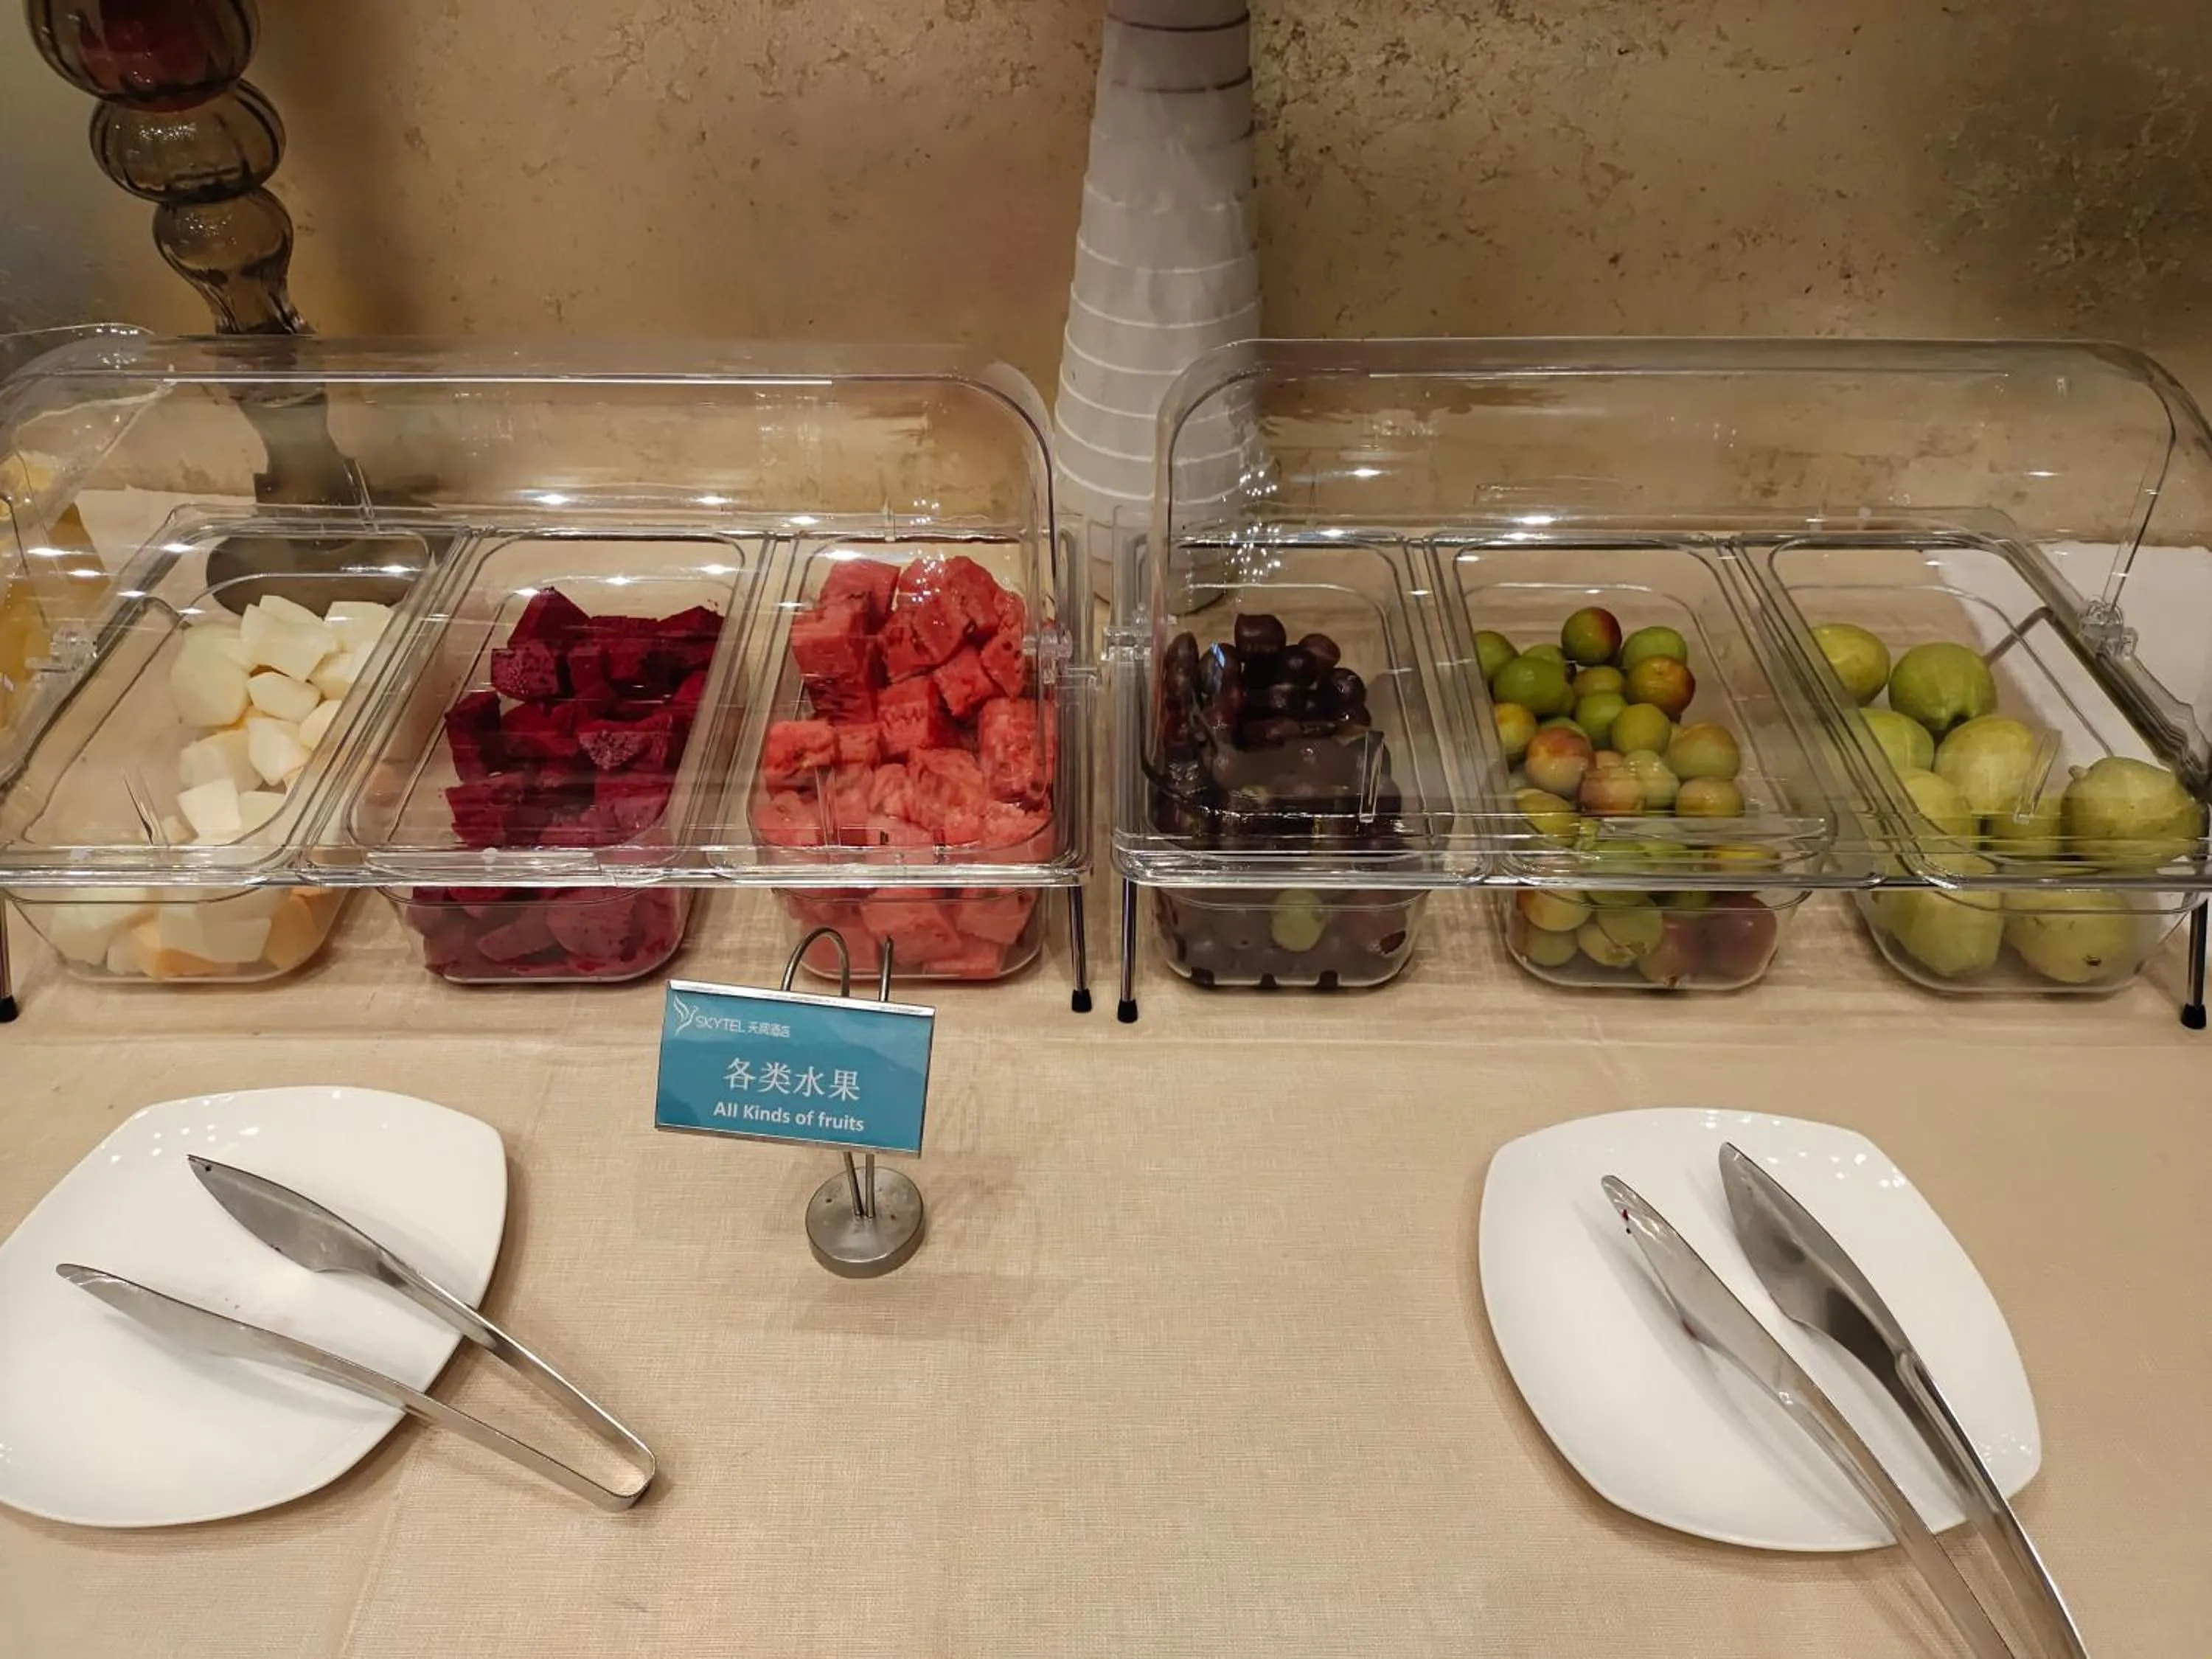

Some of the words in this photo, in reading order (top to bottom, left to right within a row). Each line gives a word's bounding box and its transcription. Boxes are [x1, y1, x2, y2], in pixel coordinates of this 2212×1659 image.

[695, 1016, 745, 1033] SKYTEL
[724, 1057, 860, 1102] 各类水果
[714, 1102, 737, 1119] All
[743, 1105, 790, 1124] Kinds
[796, 1112, 815, 1127] of
[818, 1114, 864, 1132] fruits
